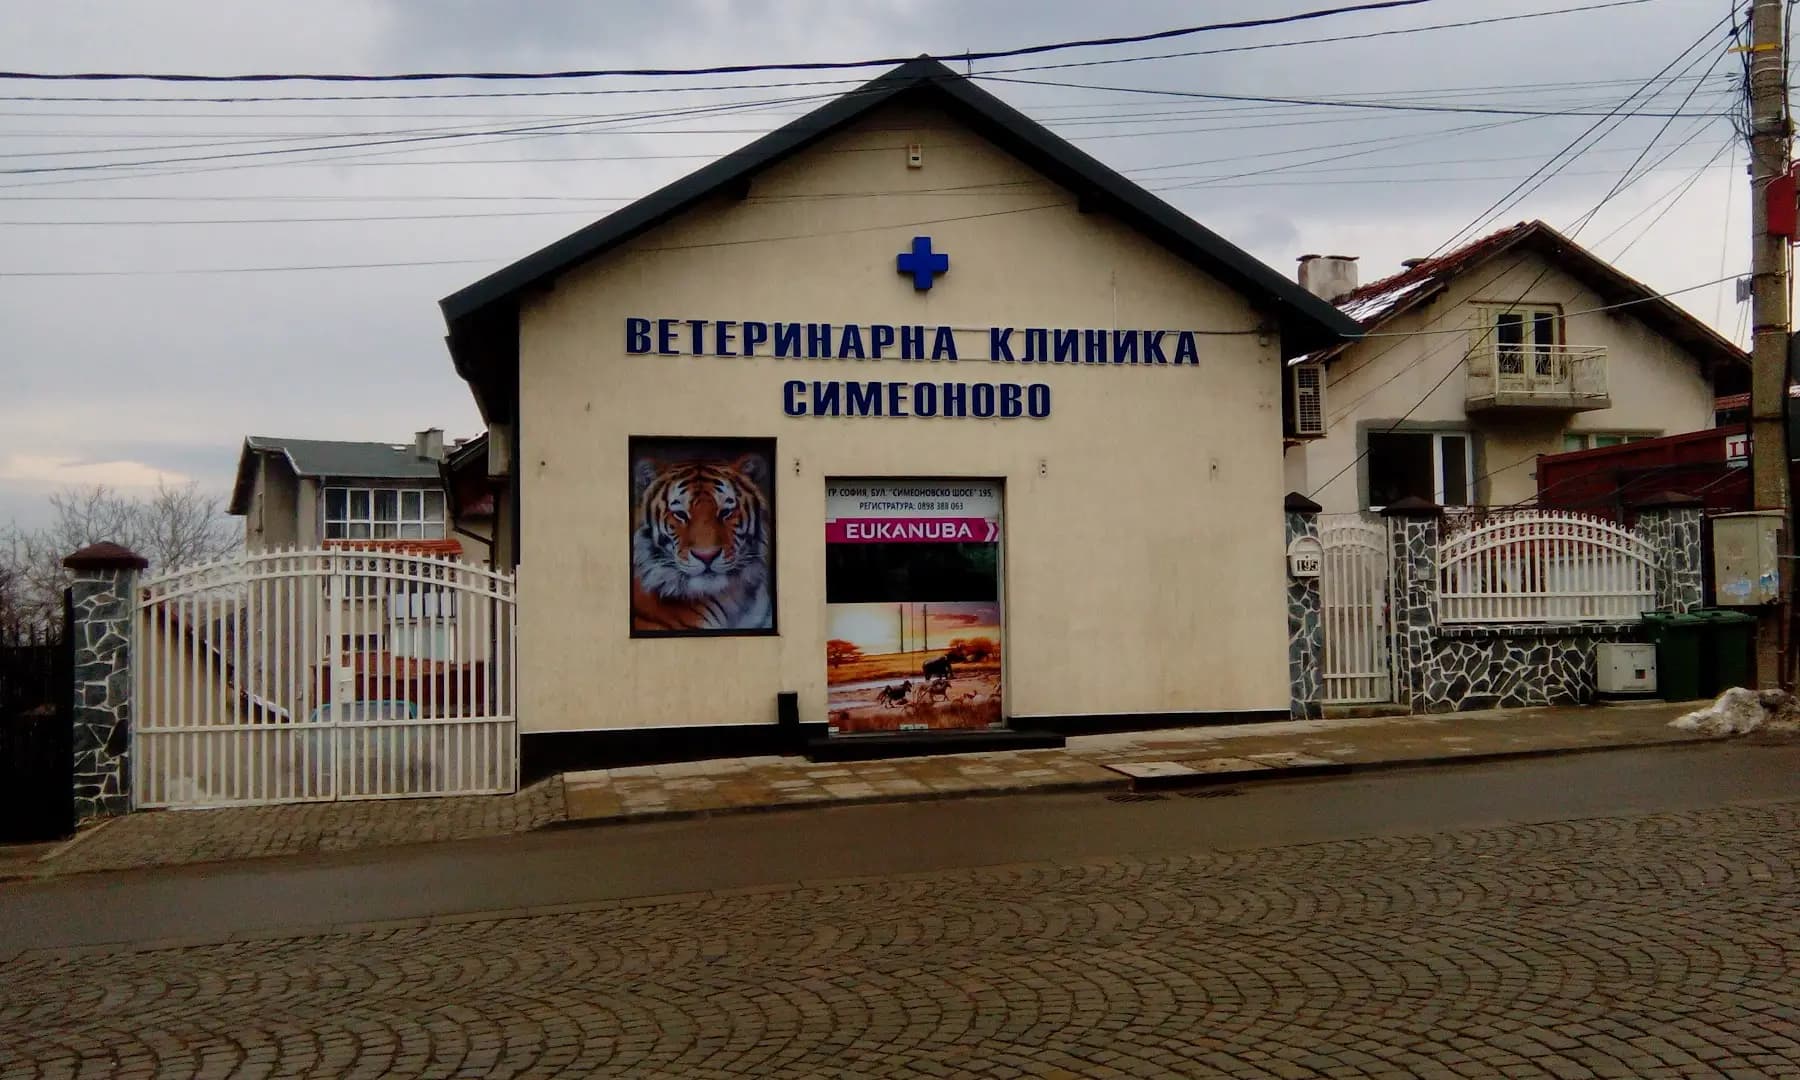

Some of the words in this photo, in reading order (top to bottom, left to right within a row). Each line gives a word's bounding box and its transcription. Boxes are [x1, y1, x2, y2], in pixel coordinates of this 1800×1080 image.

[626, 317, 959, 362] ВЕТЕРИНАРНА
[990, 327, 1200, 365] КЛИНИКА
[783, 380, 1052, 418] СИМЕОНОВО
[846, 523, 972, 539] EUKANUBA
[1297, 559, 1319, 571] 195
